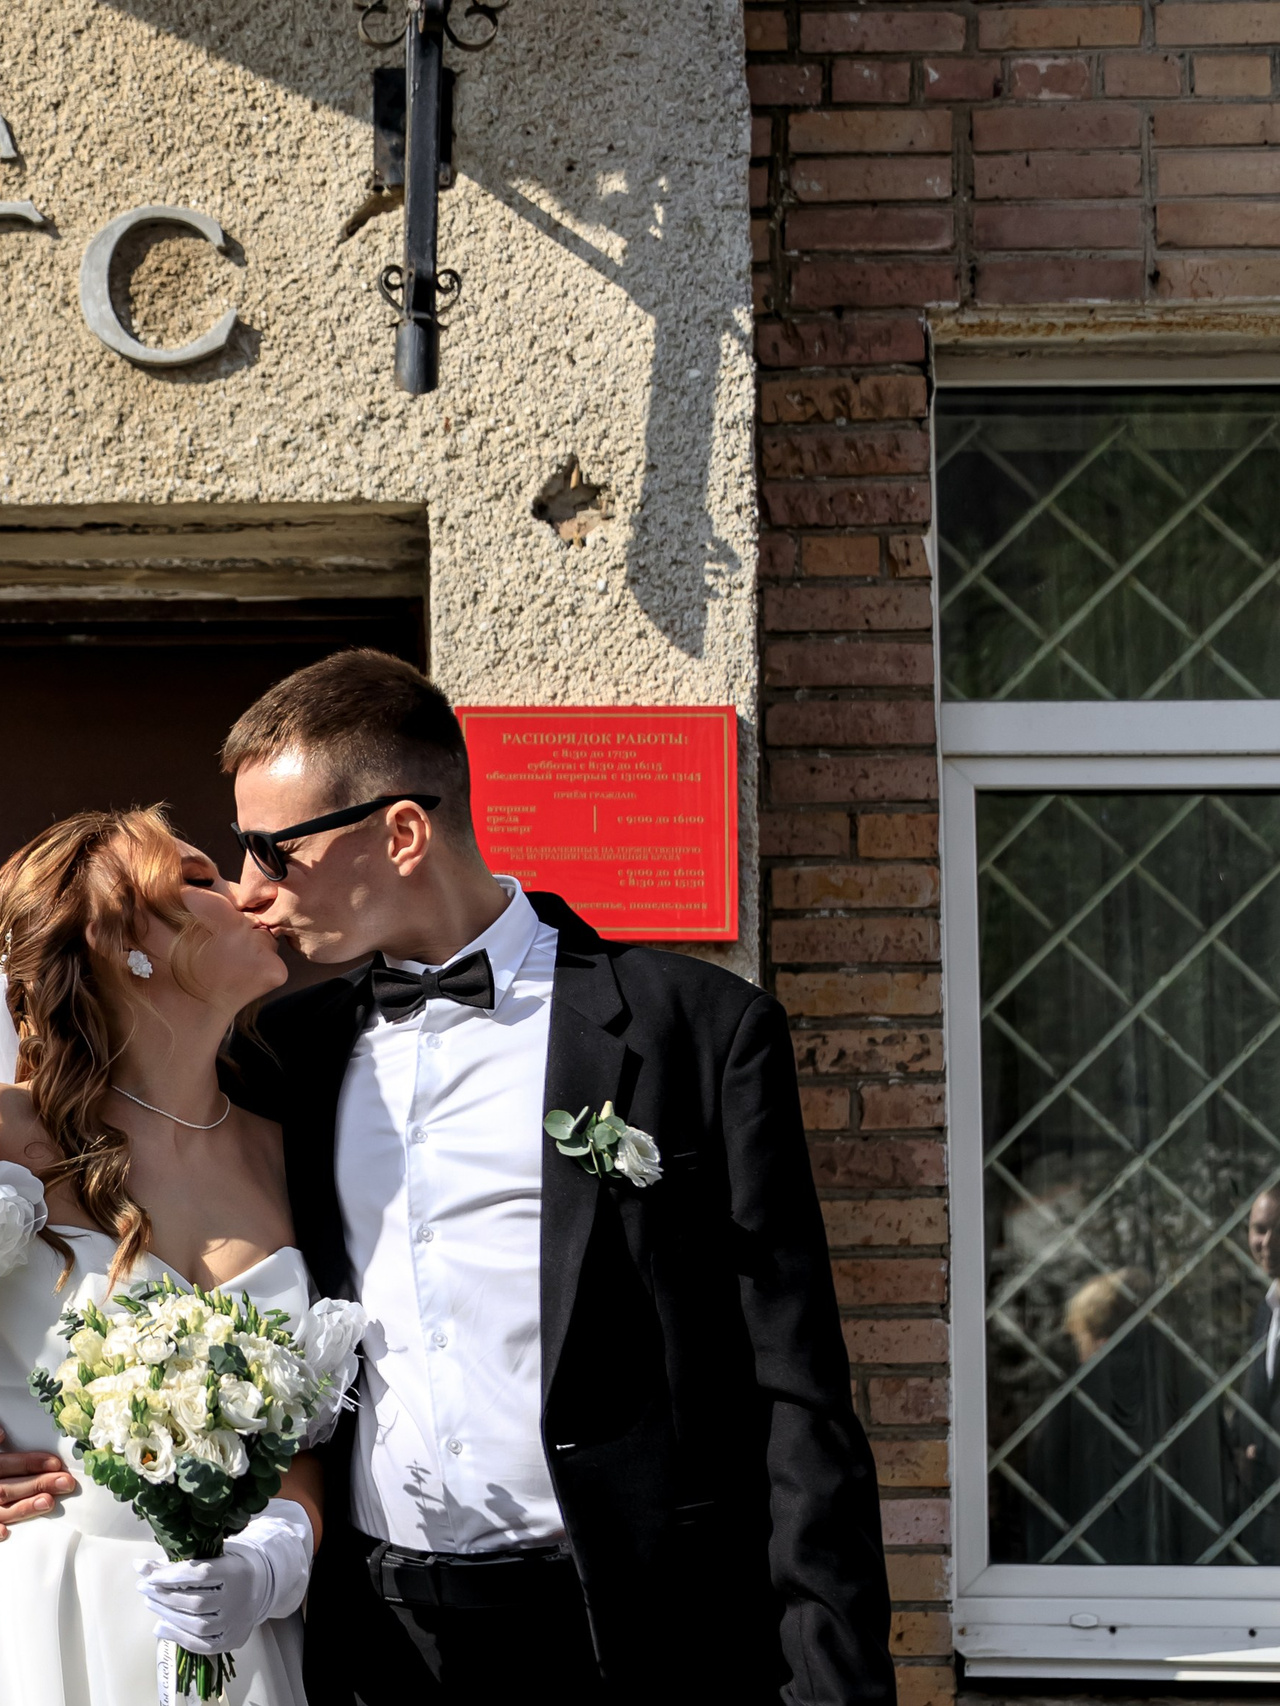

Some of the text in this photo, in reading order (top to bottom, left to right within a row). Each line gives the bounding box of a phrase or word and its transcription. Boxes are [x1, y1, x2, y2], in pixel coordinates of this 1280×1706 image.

[502, 733, 689, 745] РАСПОРЯДОК РАБОТЫ:
[563, 750, 587, 760] 8:30
[590, 751, 604, 760] до
[608, 750, 637, 760] 17:30
[527, 761, 577, 773] суббота:
[580, 763, 586, 771] с
[588, 762, 614, 773] 8:30
[617, 763, 632, 772] до
[486, 771, 553, 781] обеденный
[556, 773, 608, 783] перерыв
[611, 773, 617, 781] с
[654, 773, 669, 783] до
[486, 805, 536, 815] вторник
[486, 814, 519, 824] среда
[616, 815, 704, 825] с 9:00 до 16:00
[655, 869, 670, 879] до
[657, 879, 671, 888] до
